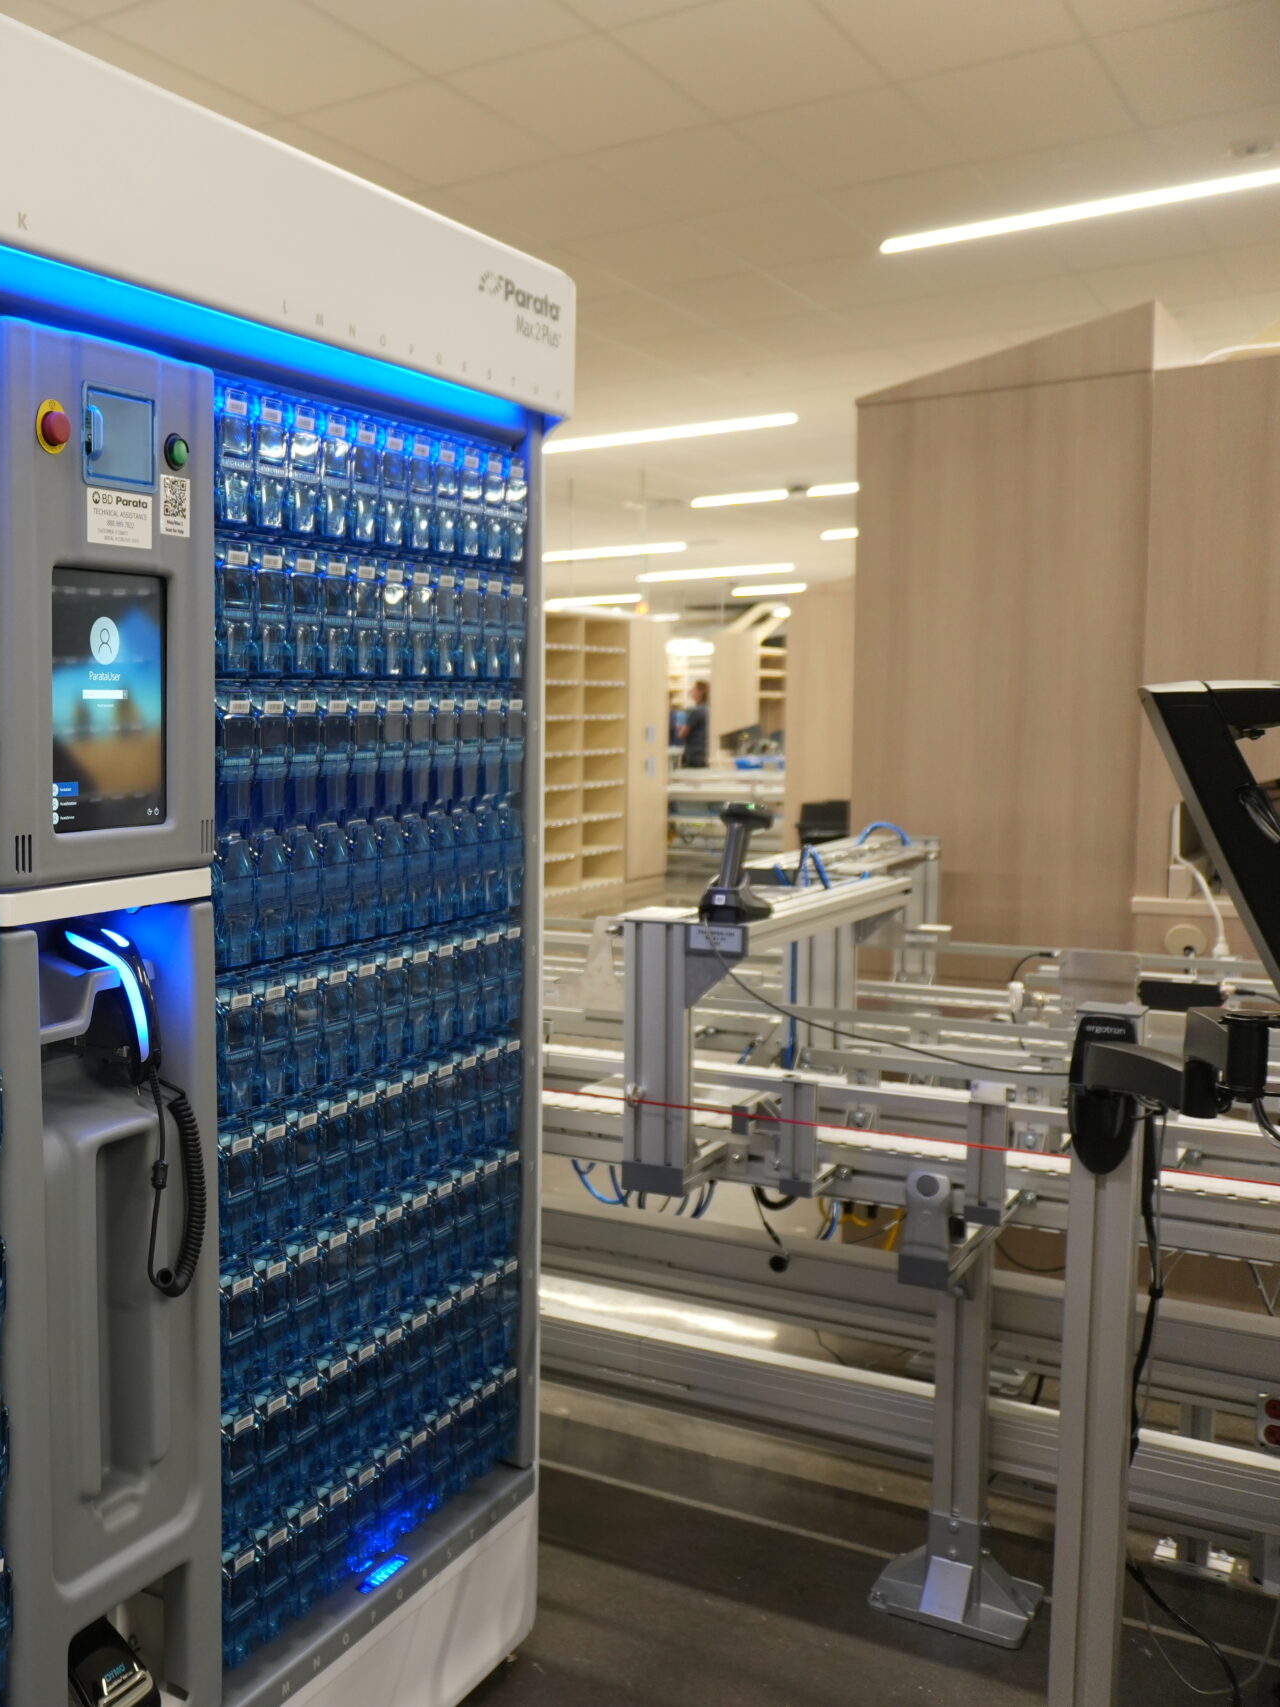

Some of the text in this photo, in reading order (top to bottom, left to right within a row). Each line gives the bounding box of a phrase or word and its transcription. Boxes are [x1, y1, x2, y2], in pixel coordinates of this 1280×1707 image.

[17, 212, 28, 231] K
[504, 278, 561, 321] Parata
[282, 299, 288, 314] L
[315, 313, 324, 327] M
[348, 324, 357, 337] N
[379, 334, 388, 347] O
[535, 323, 542, 341] 2
[542, 325, 561, 348] Plus
[101, 493, 148, 509] BD Parata
[93, 508, 148, 521] TECHNICAL ASSISTANCE
[88, 671, 121, 681] ParataUser
[1086, 1025, 1126, 1035] ergotron
[104, 1664, 126, 1682] DYMO
[282, 1681, 291, 1696] M
[313, 1656, 321, 1670] N
[342, 1634, 350, 1646] O
